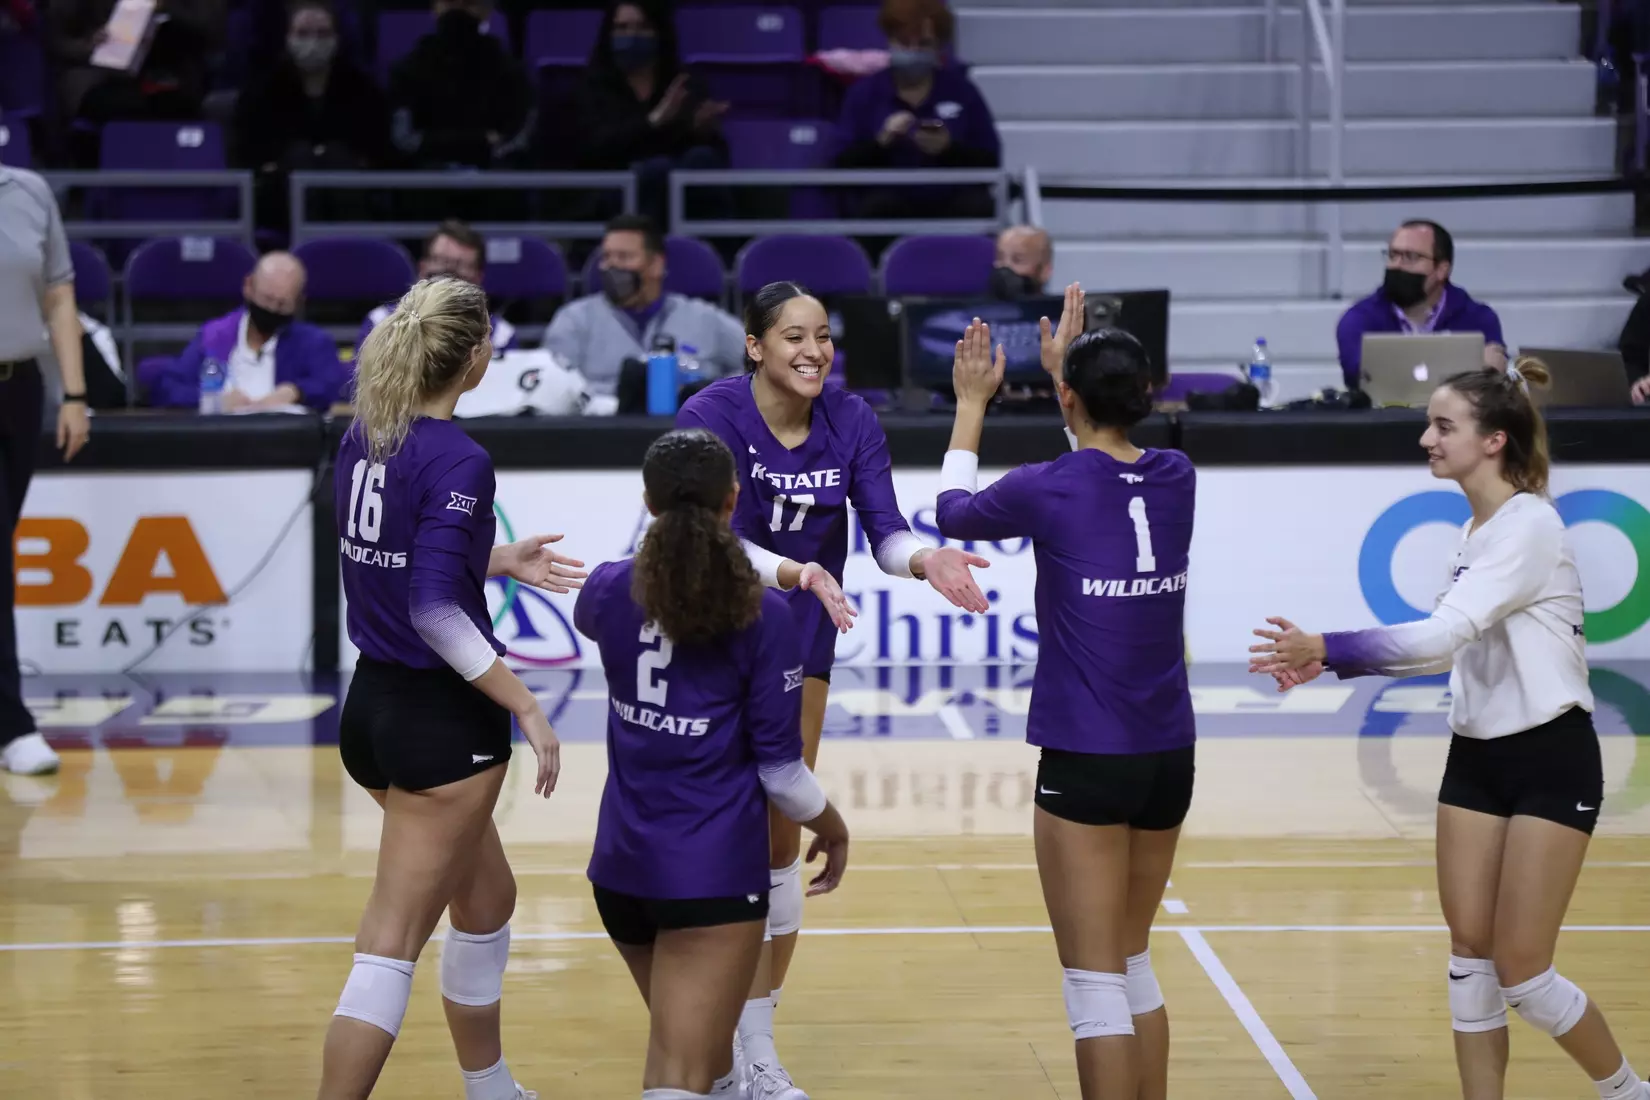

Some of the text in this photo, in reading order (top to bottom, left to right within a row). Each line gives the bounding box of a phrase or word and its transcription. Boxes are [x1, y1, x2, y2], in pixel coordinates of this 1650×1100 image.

[347, 458, 386, 543] 16
[769, 493, 815, 532] 17
[1128, 496, 1156, 572] 1
[637, 619, 674, 707] 2
[611, 696, 710, 736] WILDCATS
